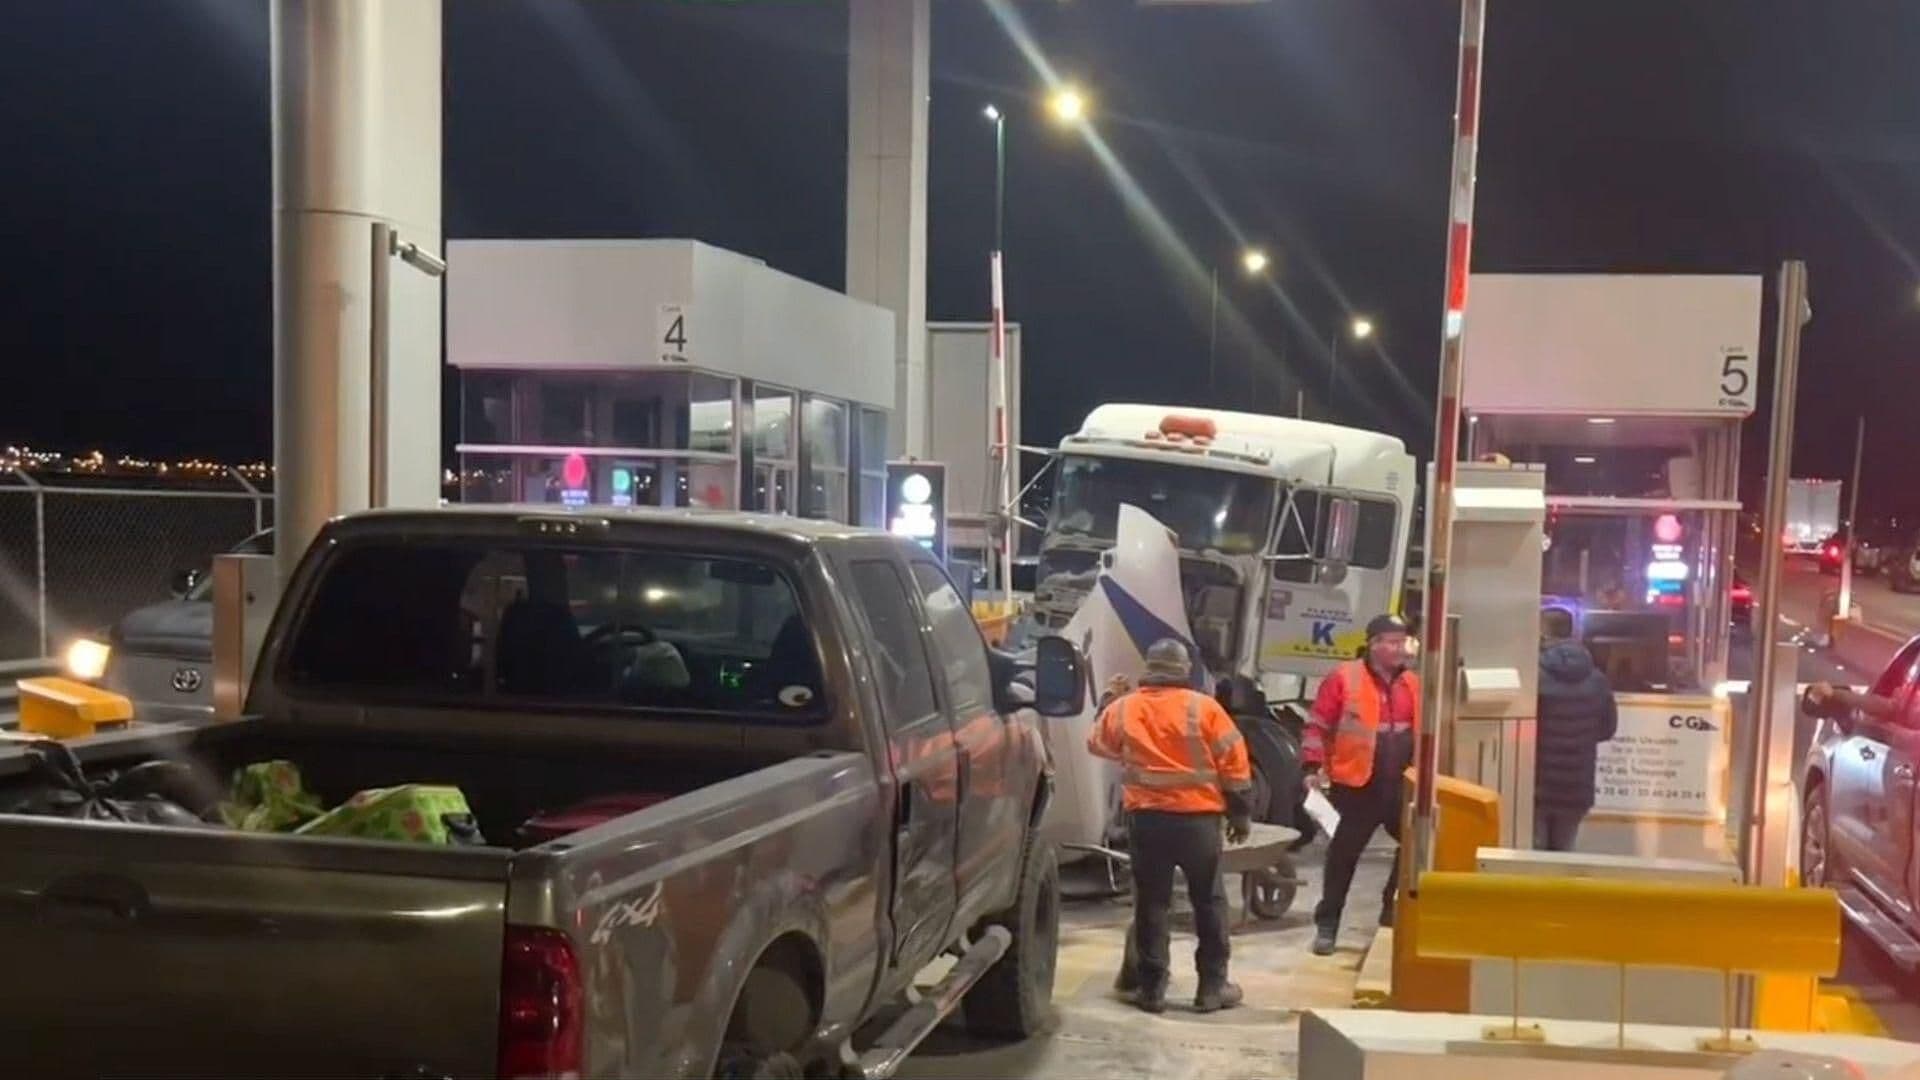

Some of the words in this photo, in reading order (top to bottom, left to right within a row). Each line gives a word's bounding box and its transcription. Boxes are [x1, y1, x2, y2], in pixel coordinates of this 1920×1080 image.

[664, 313, 688, 352] 4
[1720, 354, 1749, 396] 5
[1312, 621, 1336, 646] K
